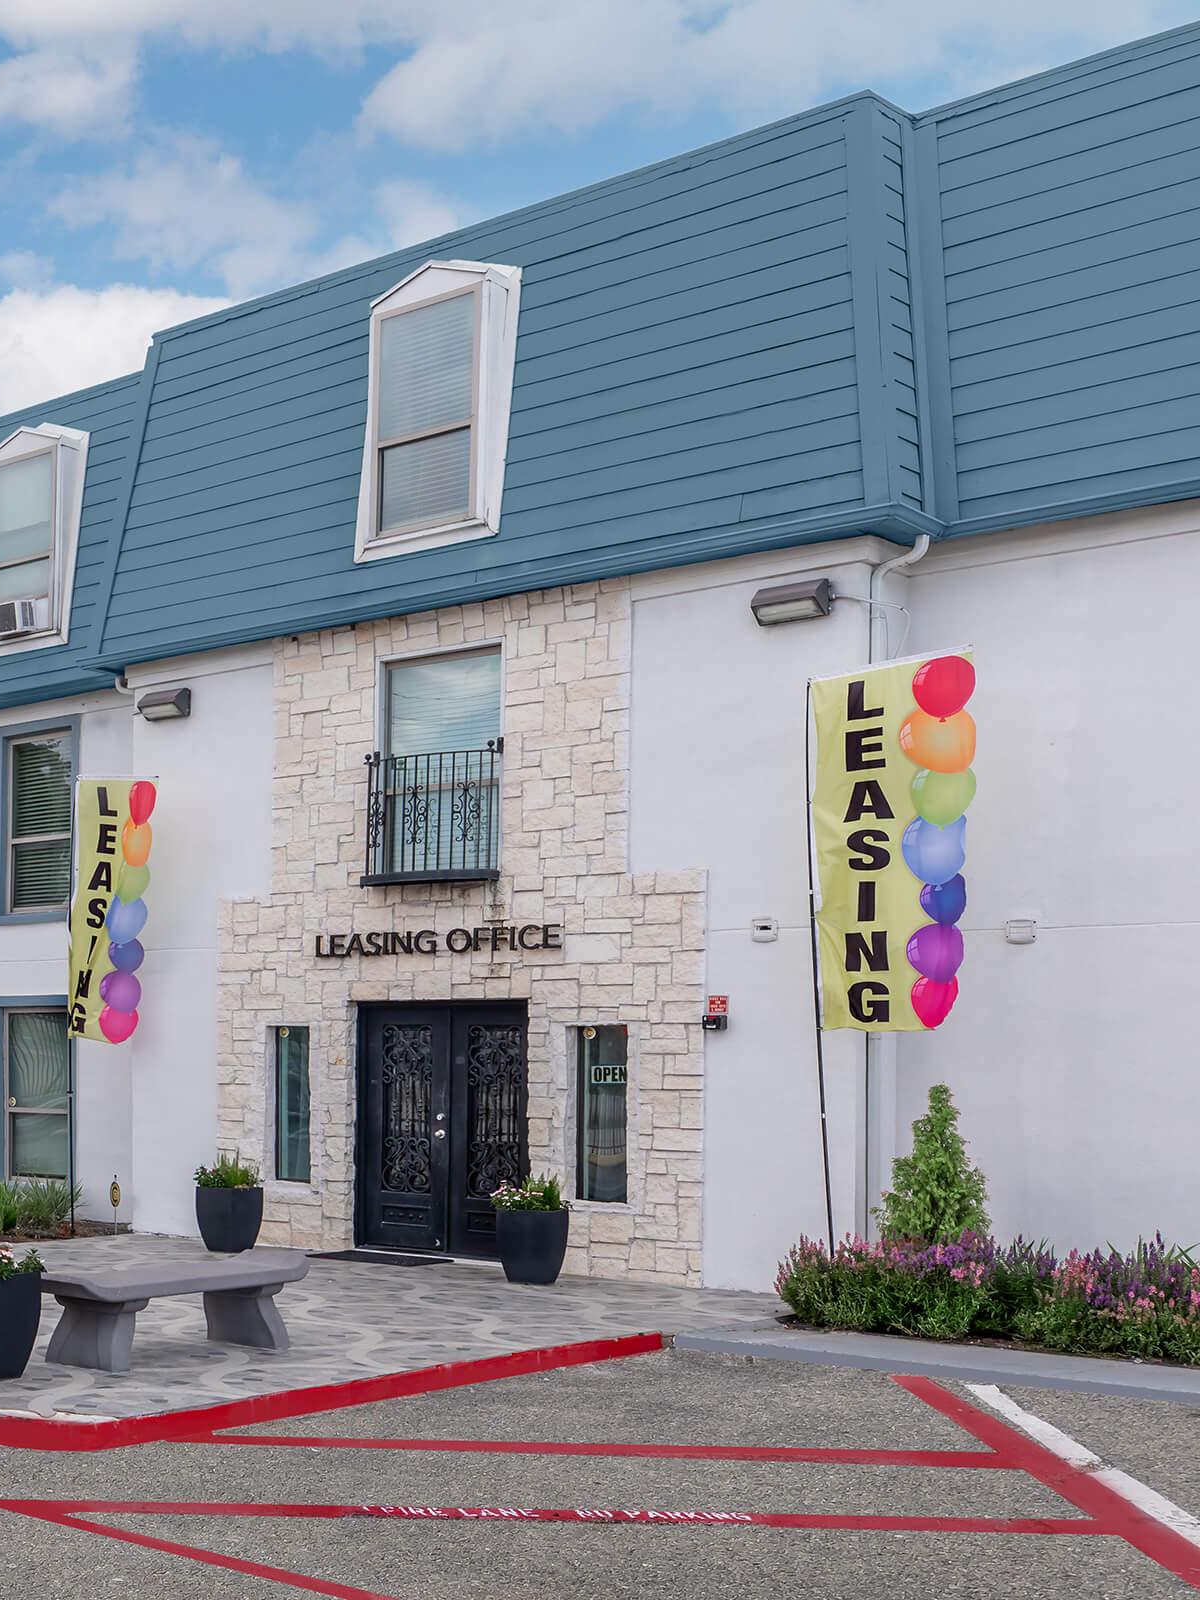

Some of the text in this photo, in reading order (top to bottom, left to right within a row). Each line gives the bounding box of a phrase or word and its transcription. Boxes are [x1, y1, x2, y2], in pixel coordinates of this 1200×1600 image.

[843, 680, 895, 1024] LEASING
[69, 786, 118, 1034] LEASING
[316, 924, 562, 958] LEASING OFFICE
[594, 1066, 627, 1082] OPEN
[380, 1506, 449, 1517] FIRE
[458, 1507, 540, 1517] LANE
[623, 1510, 752, 1521] PARKING
